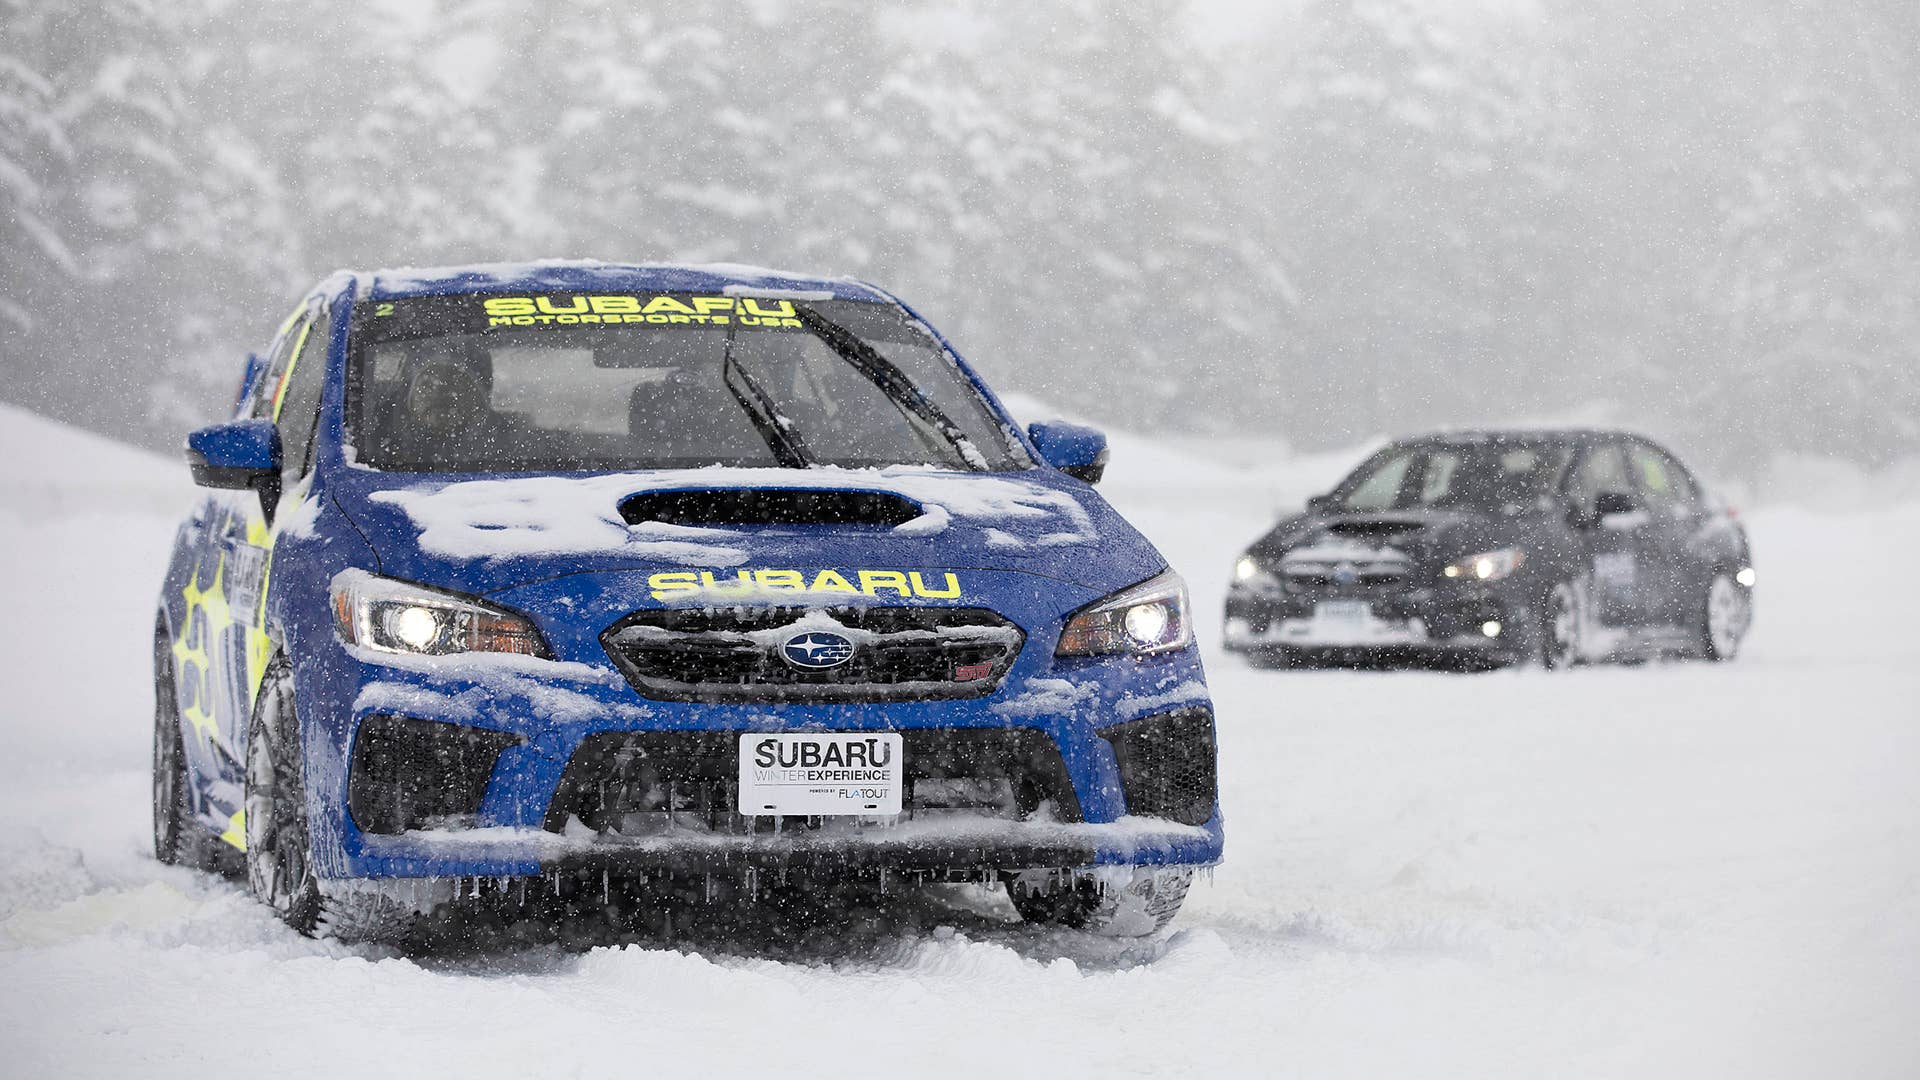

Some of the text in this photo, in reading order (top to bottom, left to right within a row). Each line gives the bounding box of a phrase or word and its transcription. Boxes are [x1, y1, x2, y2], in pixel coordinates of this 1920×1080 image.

[375, 304, 394, 317] 2
[483, 296, 796, 318] SUBARU
[489, 314, 803, 328] MOTORSPORTS USA
[754, 741, 891, 768] SUBARU
[838, 788, 889, 799] FLATOUT
